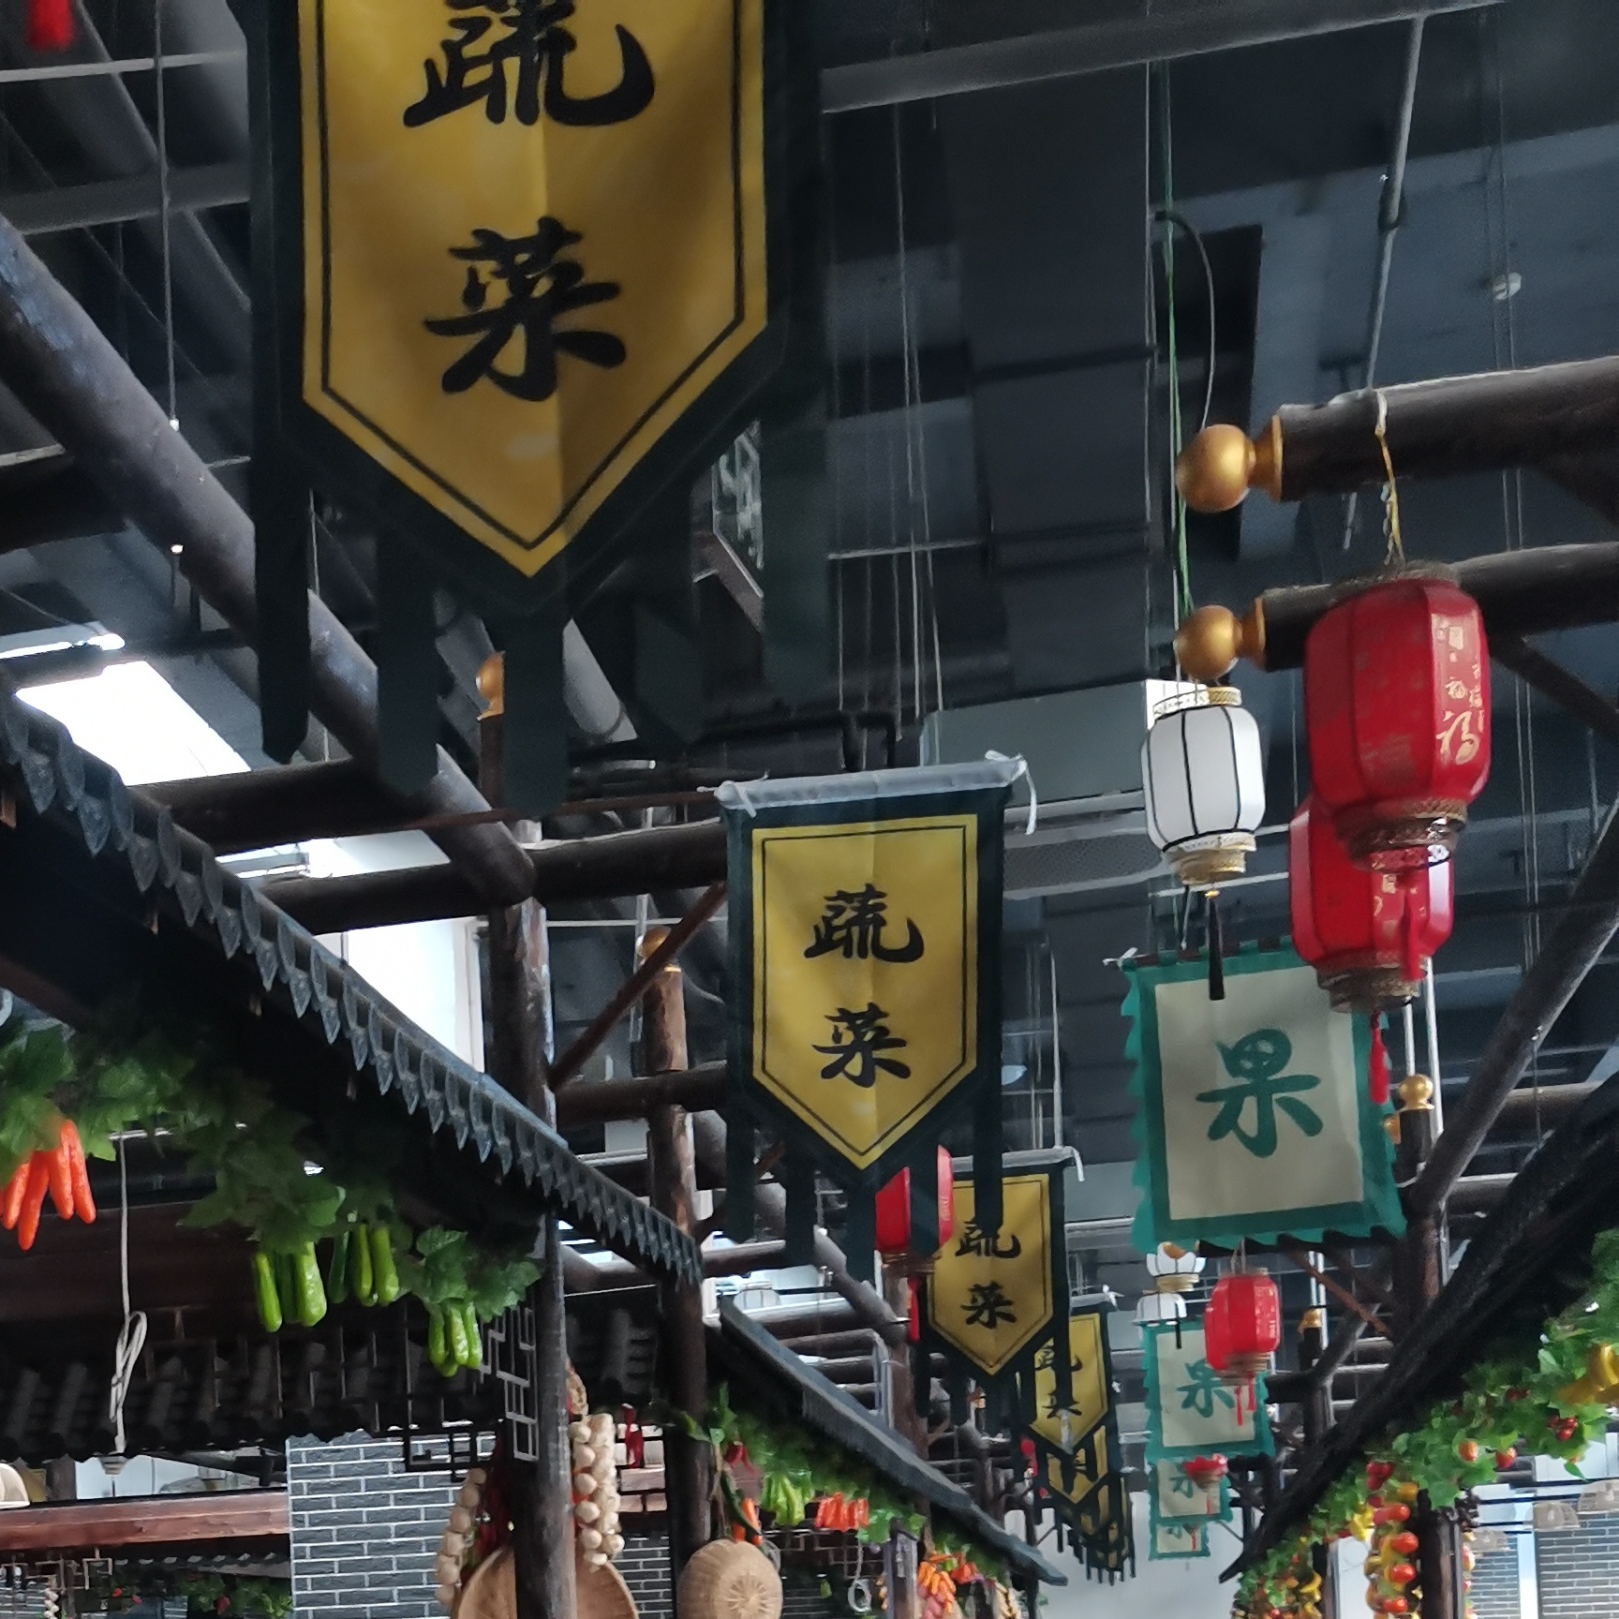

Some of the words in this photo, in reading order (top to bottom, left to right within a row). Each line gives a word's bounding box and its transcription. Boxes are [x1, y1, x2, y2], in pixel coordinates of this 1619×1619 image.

[402, 0, 655, 402] 蔬菜
[803, 882, 925, 1089] 蔬菜
[1195, 1027, 1324, 1159] 果
